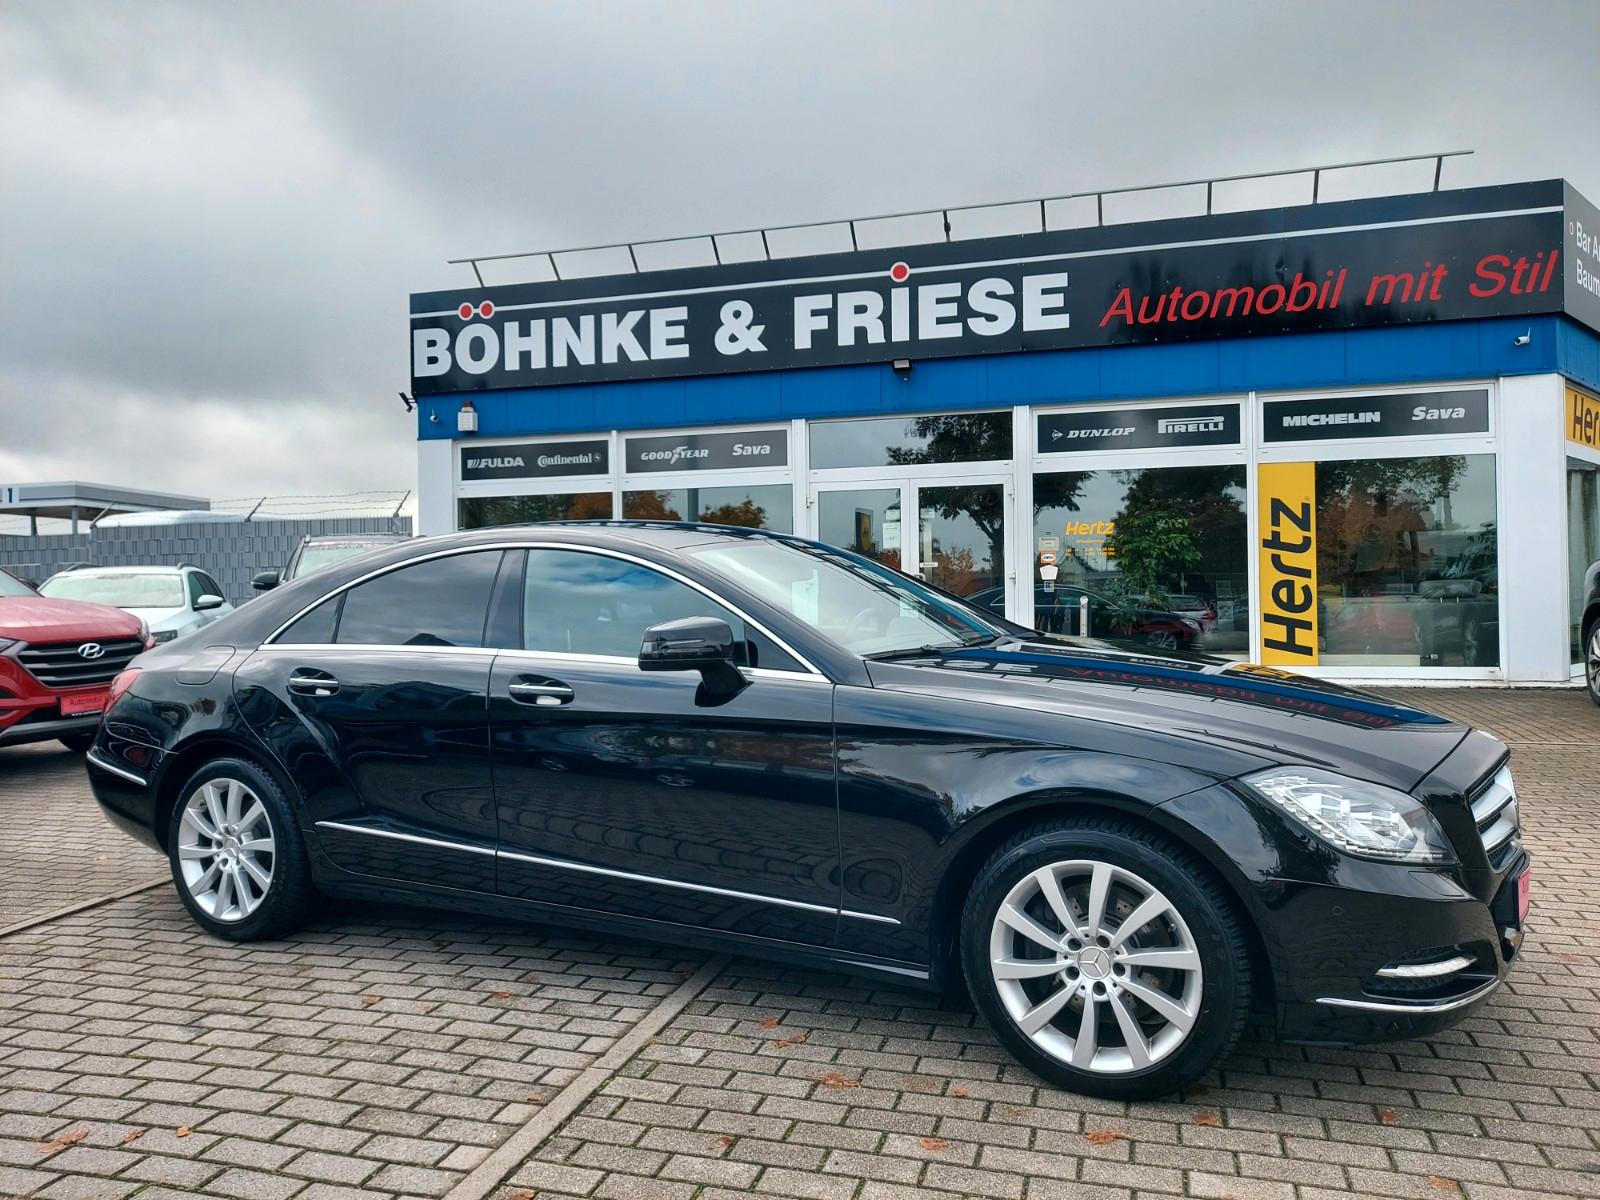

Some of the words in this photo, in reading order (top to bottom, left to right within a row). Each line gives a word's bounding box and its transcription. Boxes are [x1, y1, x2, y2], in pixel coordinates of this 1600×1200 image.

[1576, 221, 1591, 255] Bar
[1099, 268, 1348, 328] Automobil
[1365, 261, 1448, 306] mit
[1468, 250, 1559, 299] Stil
[413, 300, 690, 378] BÖHNKE
[714, 300, 769, 356] &
[794, 261, 1070, 350] FRIESE
[1282, 411, 1381, 427] MICHELIN
[1411, 406, 1466, 421] Sava
[1572, 394, 1600, 446] Her
[1157, 415, 1225, 434] PIRELLI
[1066, 427, 1136, 439] DUNLOP
[732, 443, 771, 456] Sava
[478, 456, 526, 469] FULDA
[537, 453, 593, 468] Continental
[1065, 520, 1116, 536] Hertz
[1262, 497, 1314, 657] Hertz
